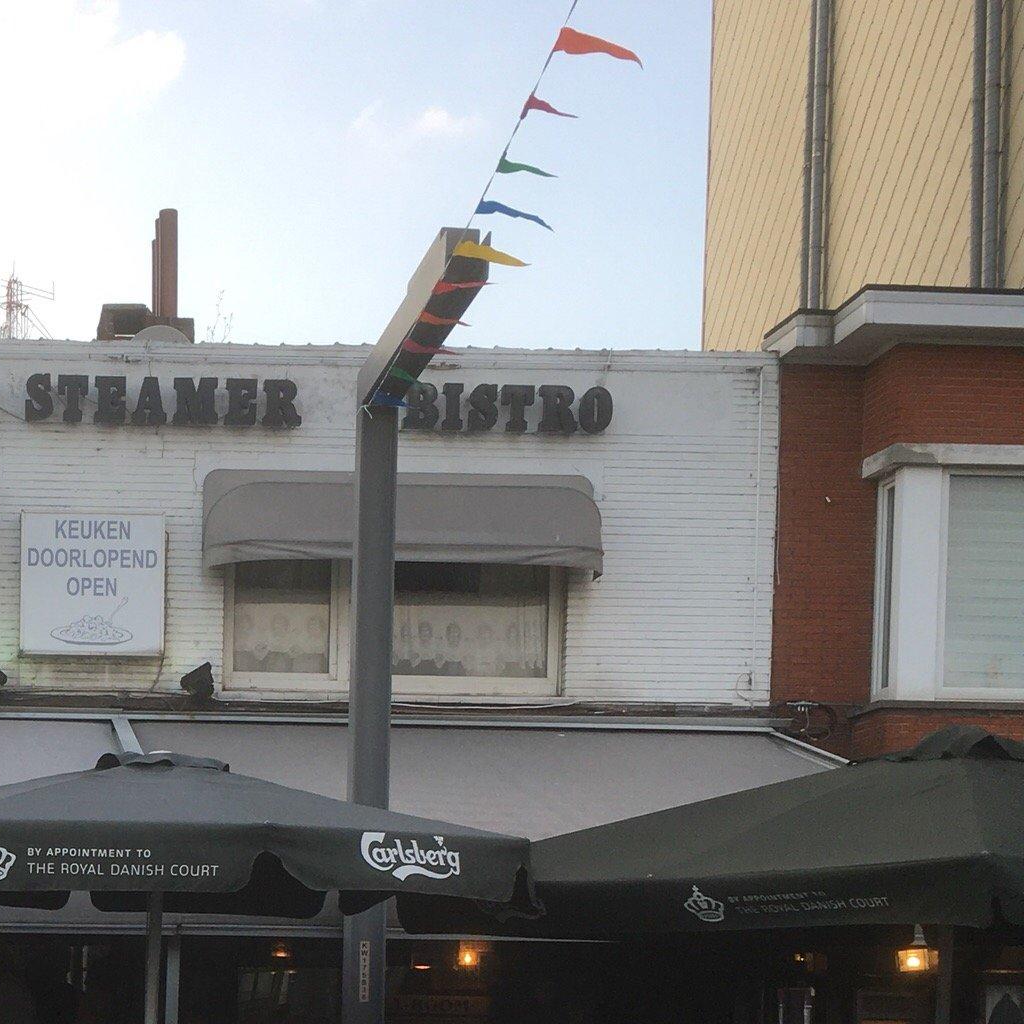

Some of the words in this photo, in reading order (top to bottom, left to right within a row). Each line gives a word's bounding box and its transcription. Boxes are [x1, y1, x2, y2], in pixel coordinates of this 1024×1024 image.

[25, 373, 303, 428] STEAMER
[402, 382, 614, 435] BISTRO
[55, 519, 132, 540] KEUKEN
[27, 547, 158, 569] DOORLOPEND
[66, 577, 118, 597] OPEN
[27, 847, 42, 857] BY
[46, 847, 131, 858] APPOINTMENT
[136, 849, 152, 858] TO
[360, 832, 461, 881] Carlsberg
[27, 862, 55, 875] THE
[61, 862, 105, 876] ROYAL
[110, 863, 165, 877] DANISH
[170, 864, 220, 877] COURT
[800, 899, 847, 911] DANISH
[848, 896, 890, 909] COURT
